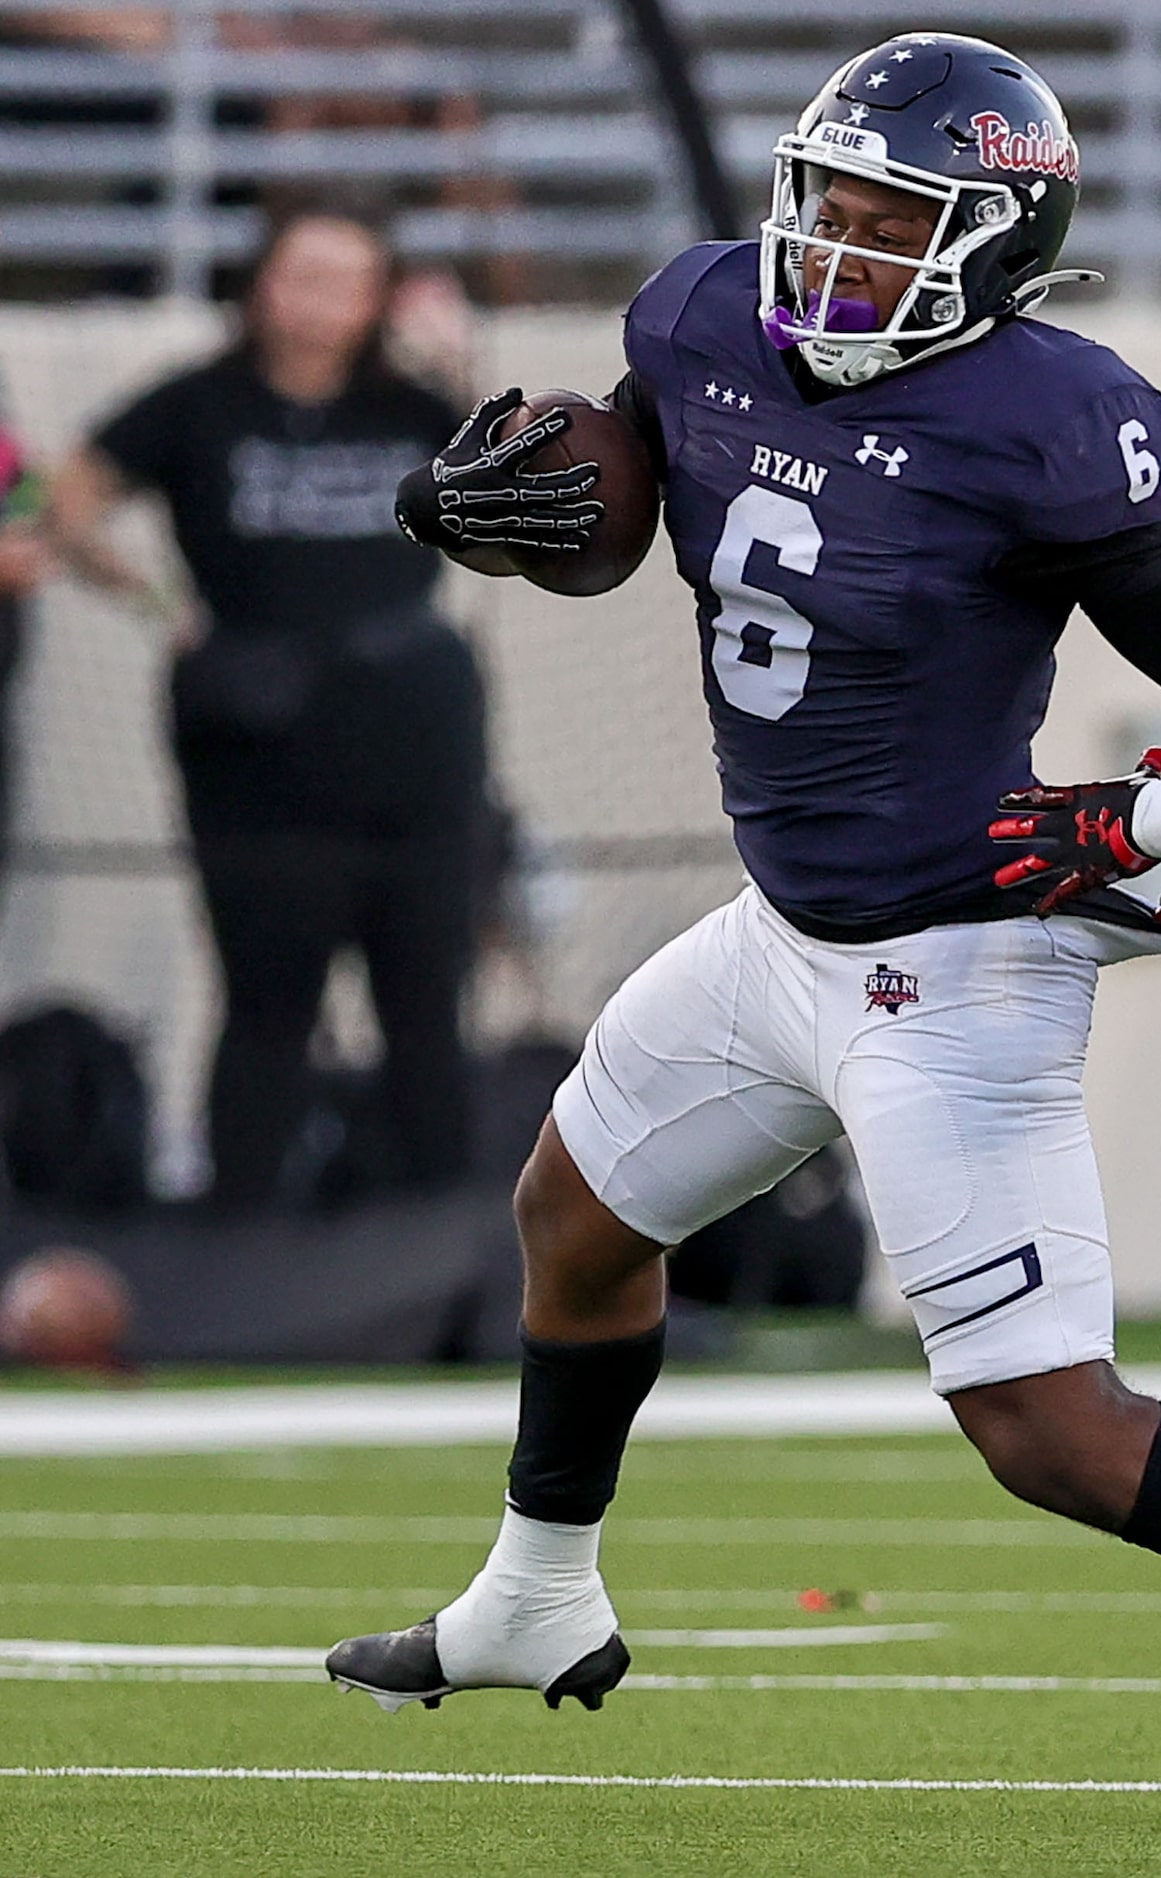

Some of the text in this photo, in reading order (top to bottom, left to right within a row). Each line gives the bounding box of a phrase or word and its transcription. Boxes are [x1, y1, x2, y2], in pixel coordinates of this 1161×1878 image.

[970, 110, 1079, 185] Raider
[749, 443, 829, 497] RYAN
[1118, 418, 1160, 504] 6
[709, 483, 825, 722] 6
[867, 975, 916, 995] RYAN
